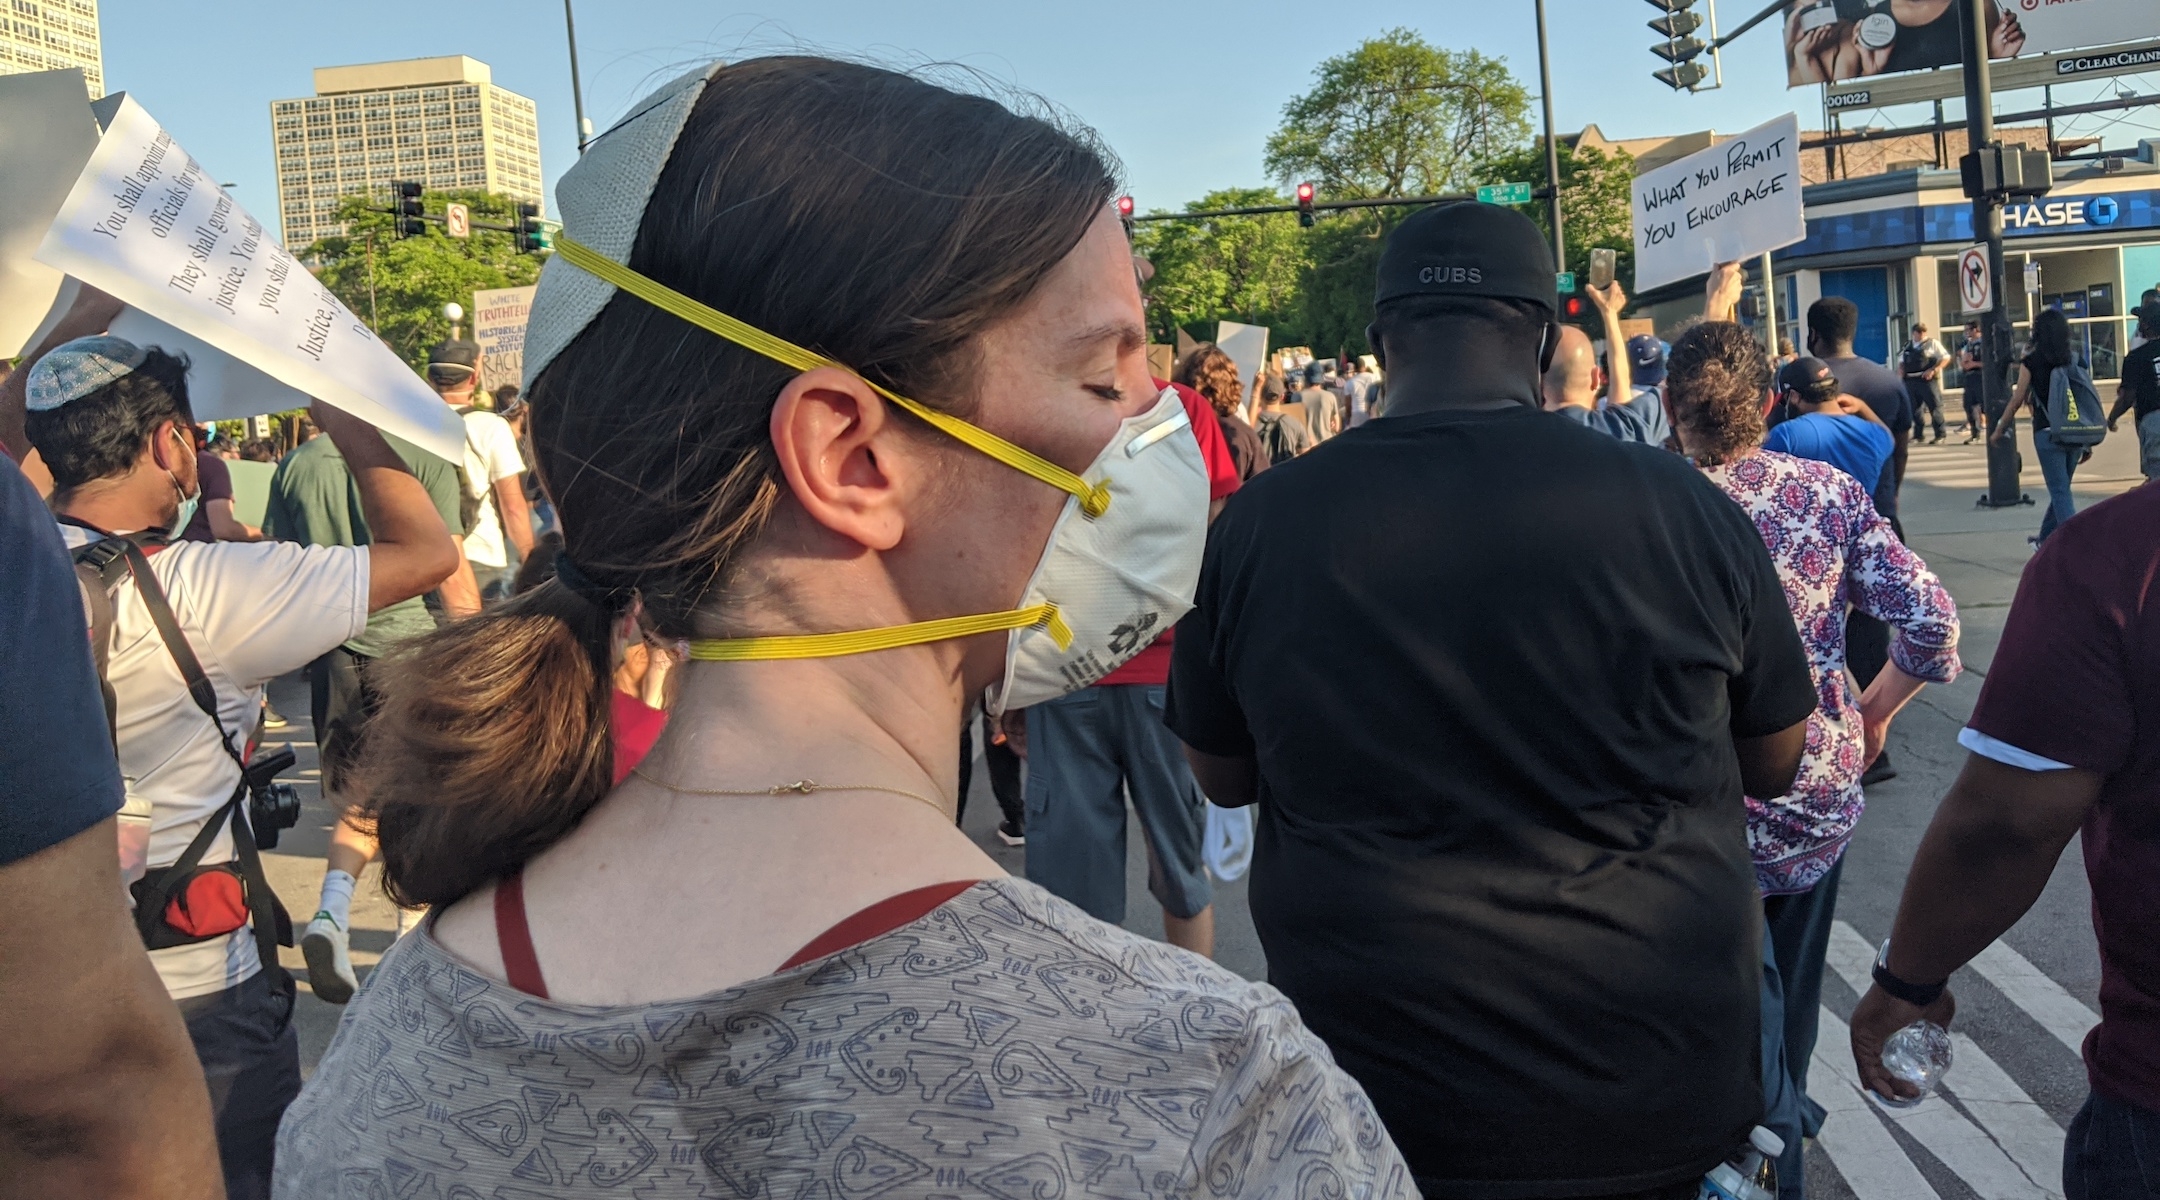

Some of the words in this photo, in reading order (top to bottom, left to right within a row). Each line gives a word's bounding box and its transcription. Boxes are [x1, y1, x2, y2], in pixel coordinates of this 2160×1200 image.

[1826, 92, 1869, 107] 001022
[93, 211, 128, 240] You
[114, 175, 147, 214] shall
[136, 142, 167, 184] appoint
[1514, 185, 1526, 195] ST
[1643, 177, 1687, 212] WHAT
[1696, 166, 1719, 189] YOU
[1727, 137, 1785, 177] PERMIT
[150, 188, 189, 239] officials
[172, 170, 197, 191] for
[1644, 222, 1675, 248] YOU
[1687, 173, 1787, 230] ENCOURAGE
[2000, 201, 2087, 229] HASE
[169, 260, 207, 294] They
[188, 226, 219, 263] shall
[208, 196, 234, 234] govern
[208, 266, 248, 316] justice.
[230, 238, 258, 262] You
[266, 253, 292, 286] shall
[1419, 266, 1482, 284] CUBS
[259, 284, 281, 315] you
[297, 308, 339, 361] Justice,
[485, 372, 495, 390] IS
